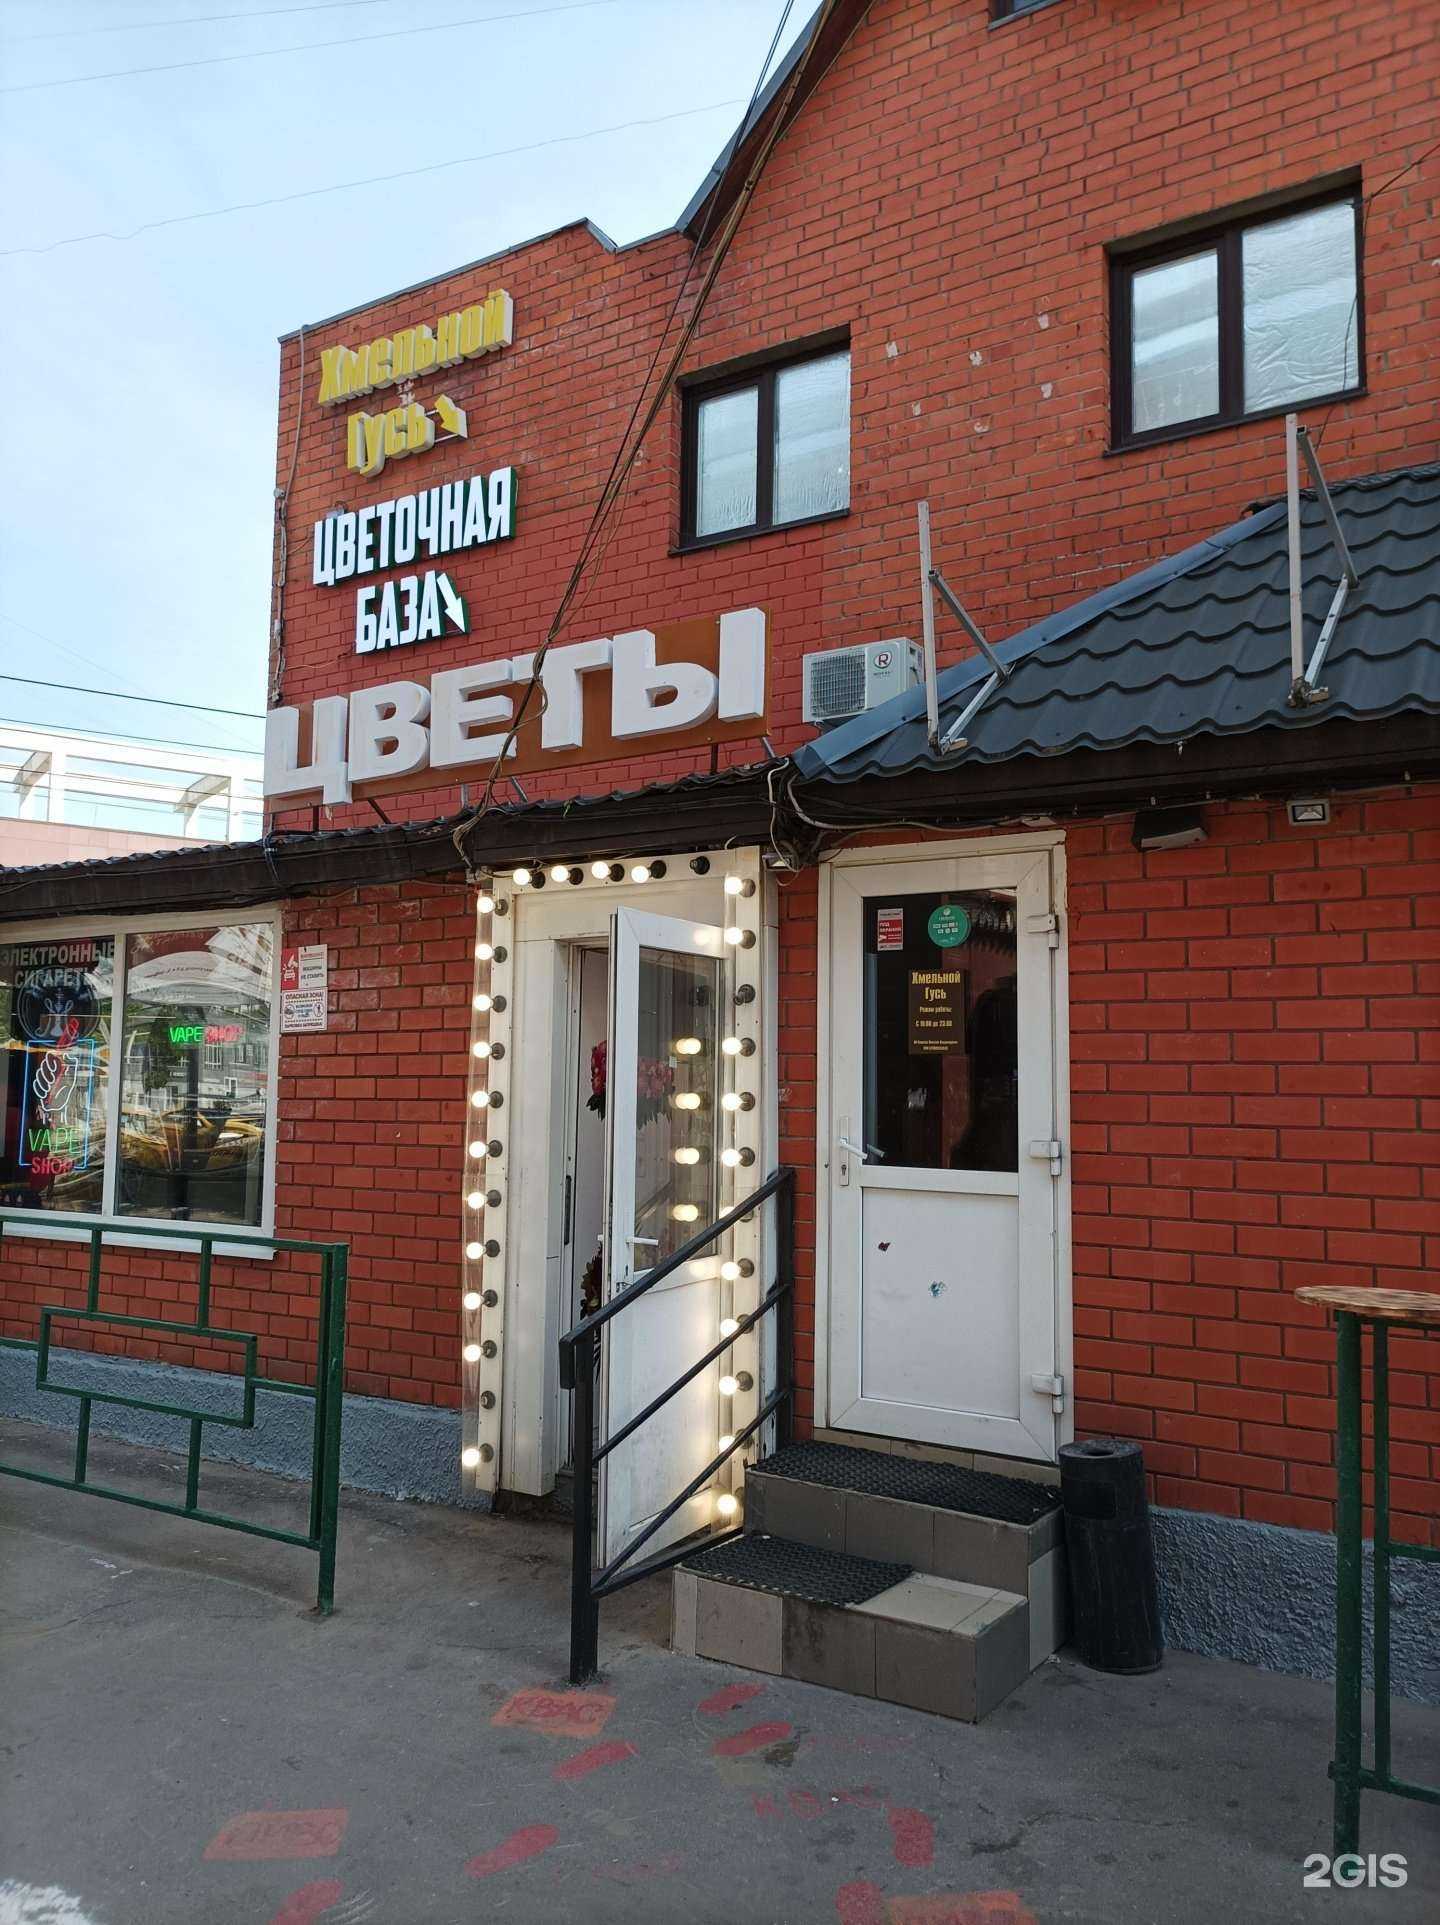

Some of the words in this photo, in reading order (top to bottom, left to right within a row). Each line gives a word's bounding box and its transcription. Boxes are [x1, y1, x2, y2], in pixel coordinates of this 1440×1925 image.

[346, 401, 435, 477] Гусь
[312, 466, 516, 587] ЦВЕТОЧНАЯ
[355, 570, 440, 655] БАЗА
[264, 606, 766, 805] ЦВЕТЫ
[1, 942, 114, 967] ЭЛЕКТРОННЫЕ
[912, 971, 960, 984] Хмельной
[924, 986, 947, 1001] Гусь
[169, 1026, 202, 1042] VAPE
[28, 1127, 82, 1154] VAPE
